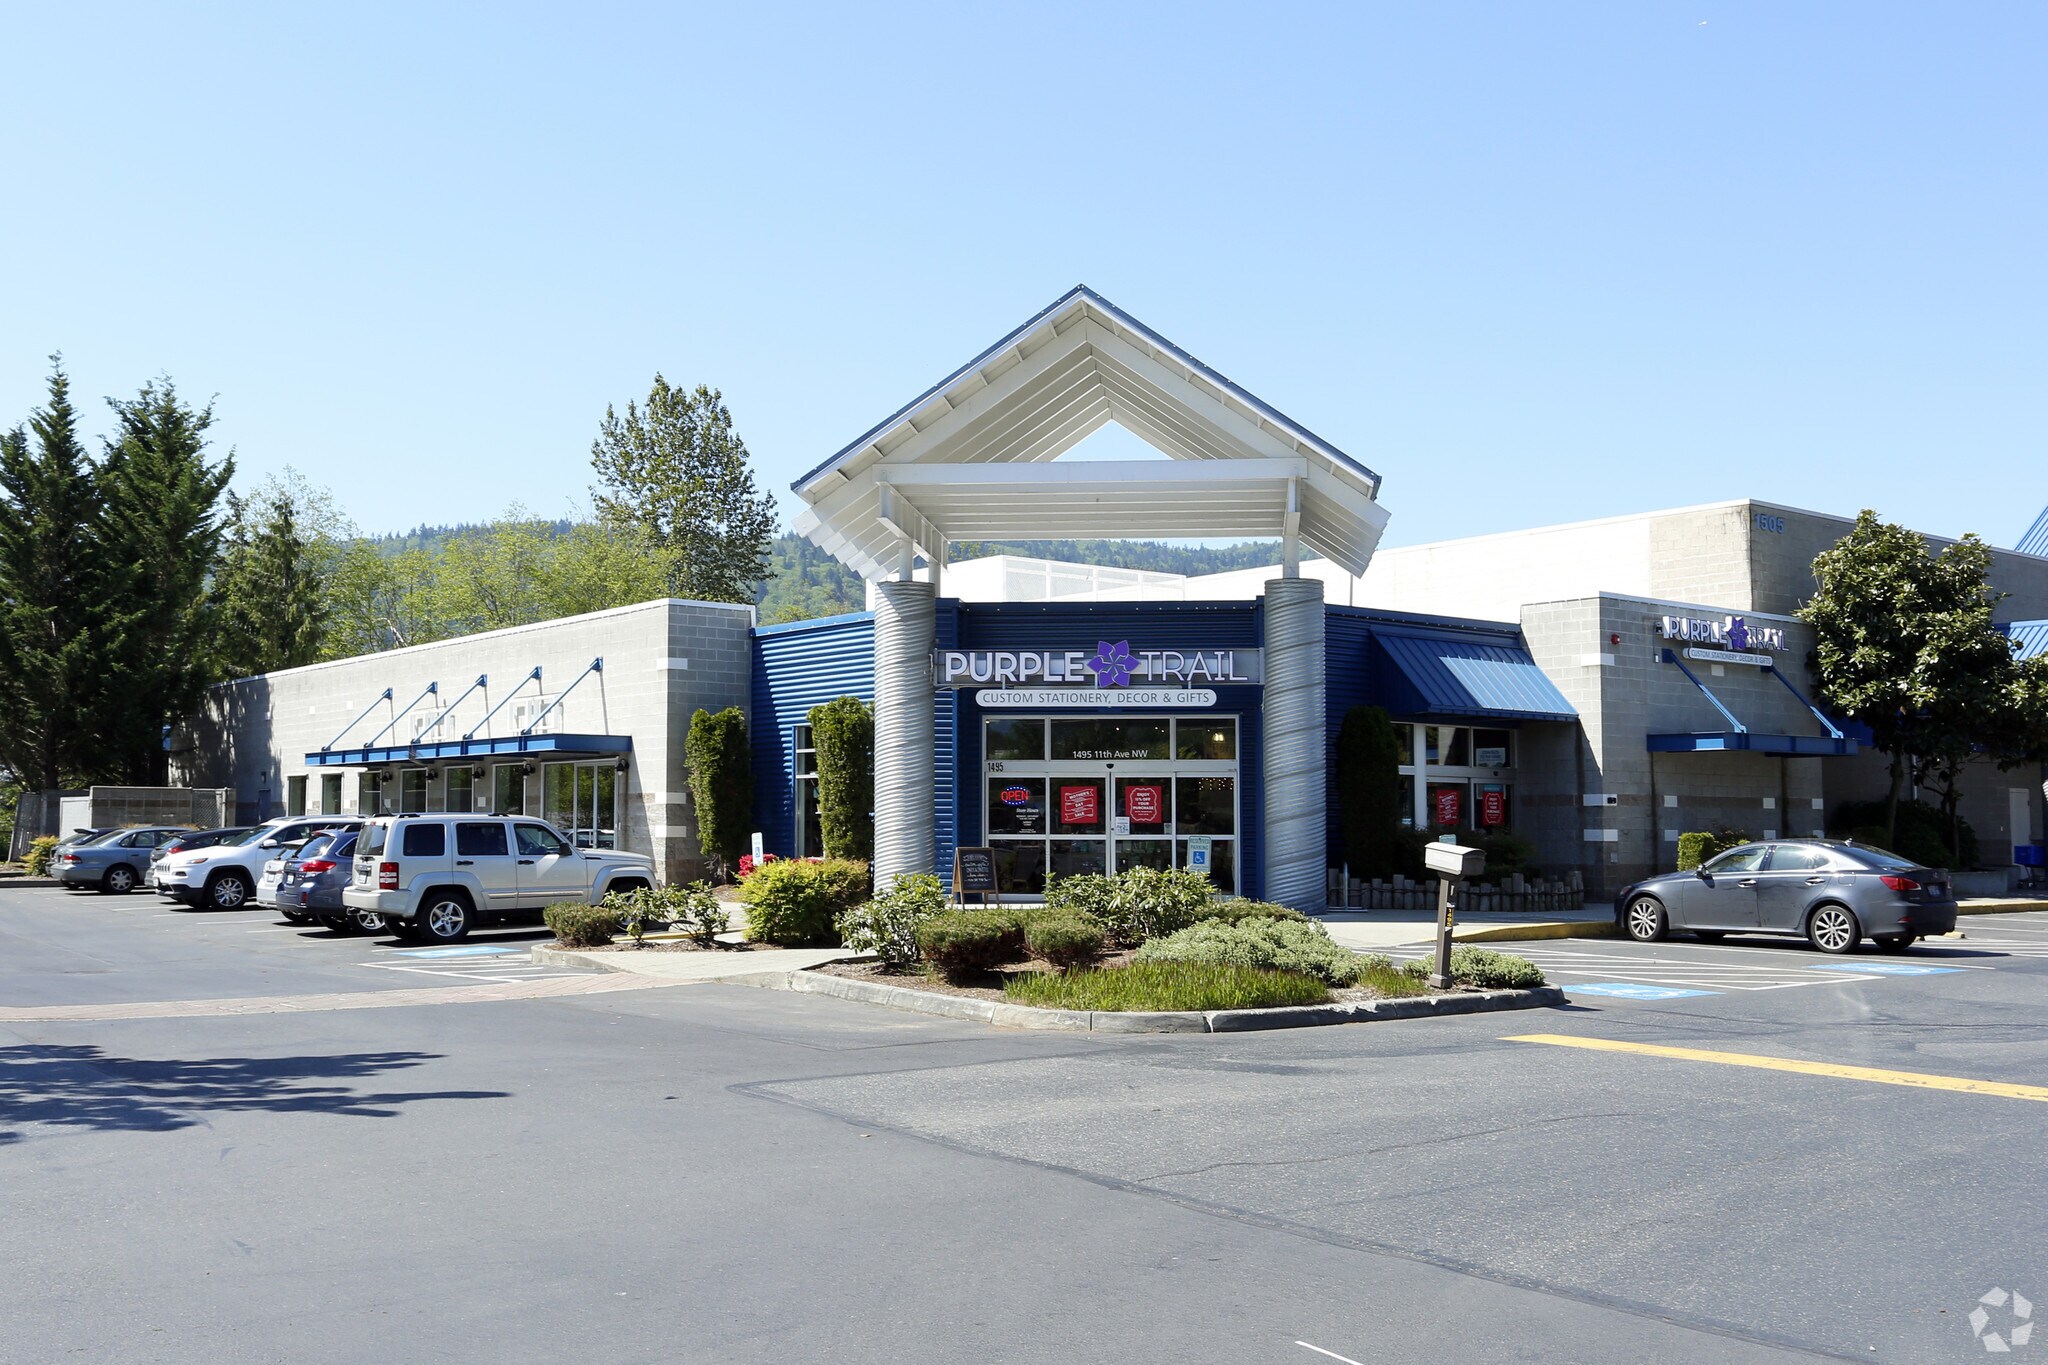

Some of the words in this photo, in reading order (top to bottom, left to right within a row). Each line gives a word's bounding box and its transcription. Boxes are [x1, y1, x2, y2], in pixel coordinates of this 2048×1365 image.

[1754, 513, 1785, 534] 1505
[1667, 617, 1728, 644] PURPLE
[1747, 625, 1789, 651] TRAIL
[1691, 649, 1711, 658] CUSTOM
[945, 652, 1085, 682] PURPLE
[1139, 651, 1248, 681] TRAIL
[982, 693, 1033, 703] CUSTOM
[1039, 693, 1111, 704] STATIONERY,
[1117, 693, 1157, 703] DECOR
[1163, 693, 1171, 703] &
[1177, 692, 1210, 703] GIFTS
[1072, 750, 1092, 759] 1495
[1094, 750, 1113, 758] 11th
[1114, 750, 1130, 758] Ave
[1131, 749, 1148, 758] NW
[987, 762, 1004, 772] 1495
[1001, 790, 1029, 801] OPEN
